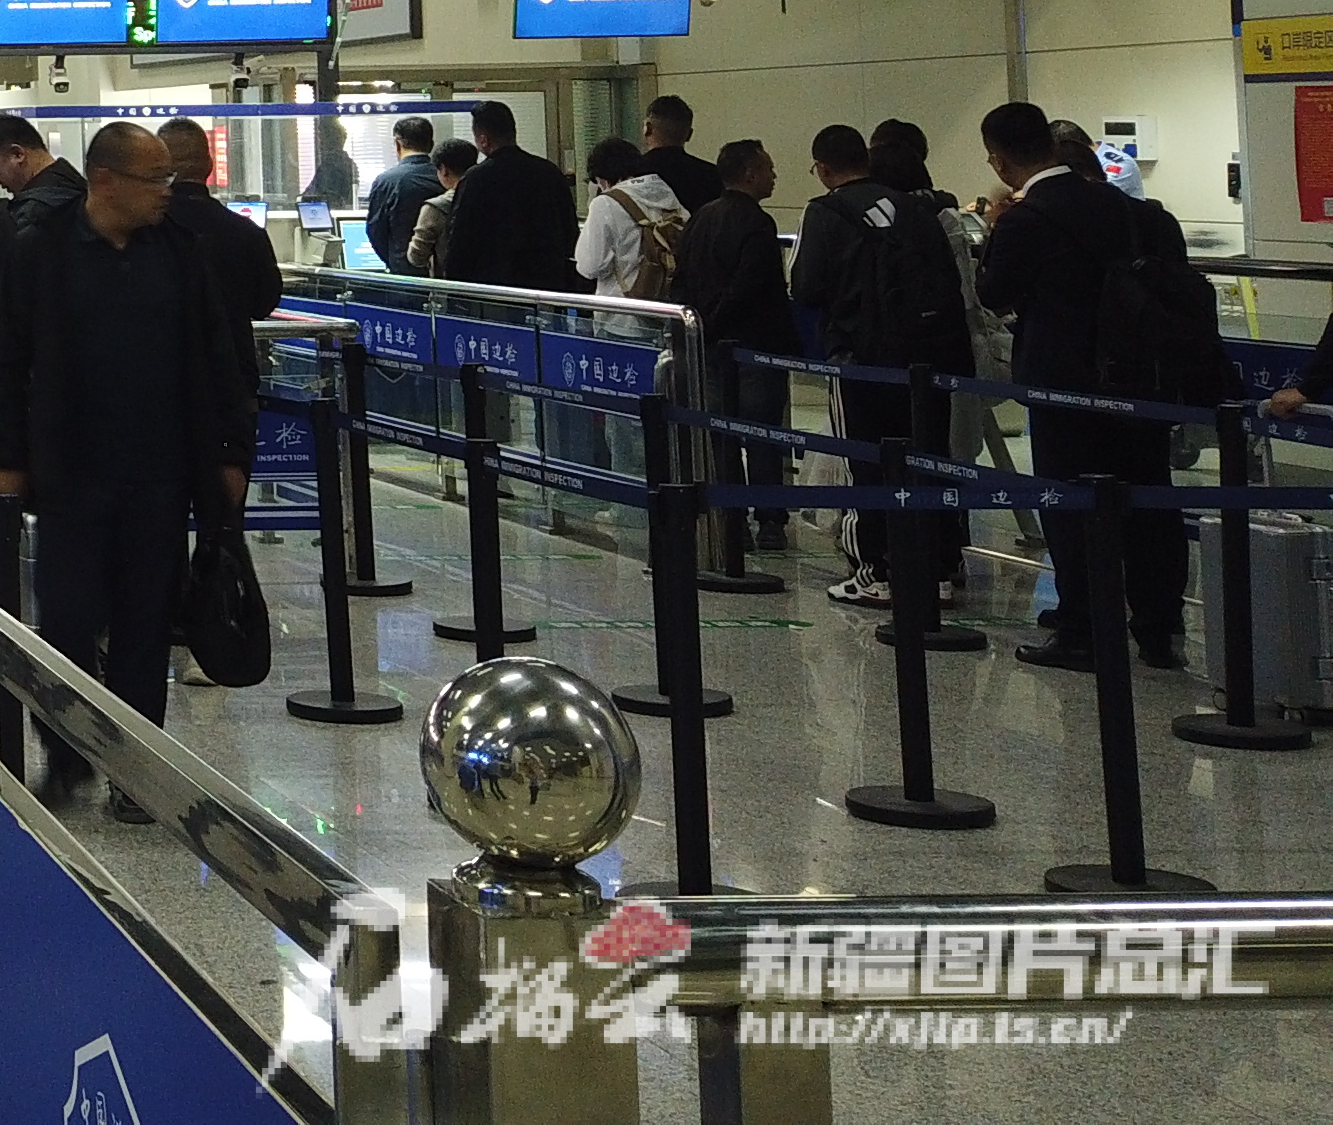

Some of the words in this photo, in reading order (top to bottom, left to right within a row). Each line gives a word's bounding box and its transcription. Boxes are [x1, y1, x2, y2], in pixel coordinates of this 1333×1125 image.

[374, 320, 418, 349] 中国边检
[468, 334, 519, 366] 中国边检
[579, 353, 639, 389] 中国边检
[256, 453, 310, 462] INSPECTION
[543, 470, 584, 489] INSPECTION
[936, 461, 979, 480] INSPECTION
[894, 487, 1064, 508] 中国边检
